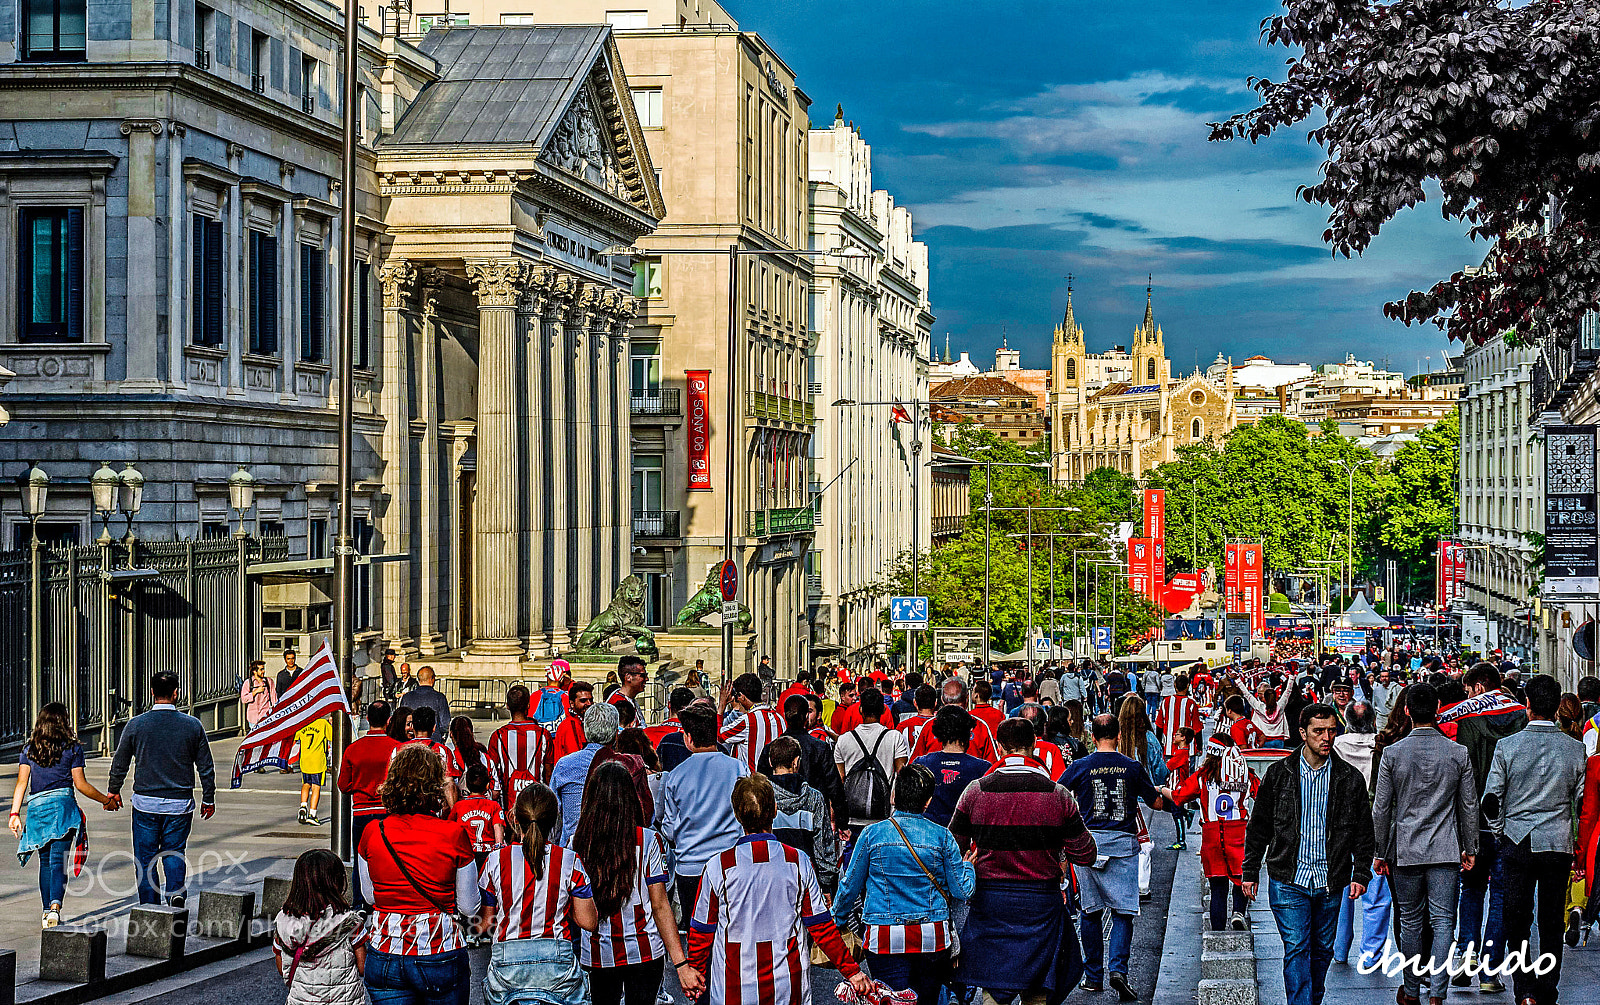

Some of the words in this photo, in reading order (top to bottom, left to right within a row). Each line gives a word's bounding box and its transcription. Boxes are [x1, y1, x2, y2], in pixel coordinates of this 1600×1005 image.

[691, 399, 704, 434] AÑOS
[693, 436, 705, 451] 90
[1547, 497, 1587, 511] FIEL
[1546, 511, 1596, 525] TROS
[306, 733, 314, 750] 7
[1215, 793, 1234, 820] 9
[470, 819, 485, 843] 7
